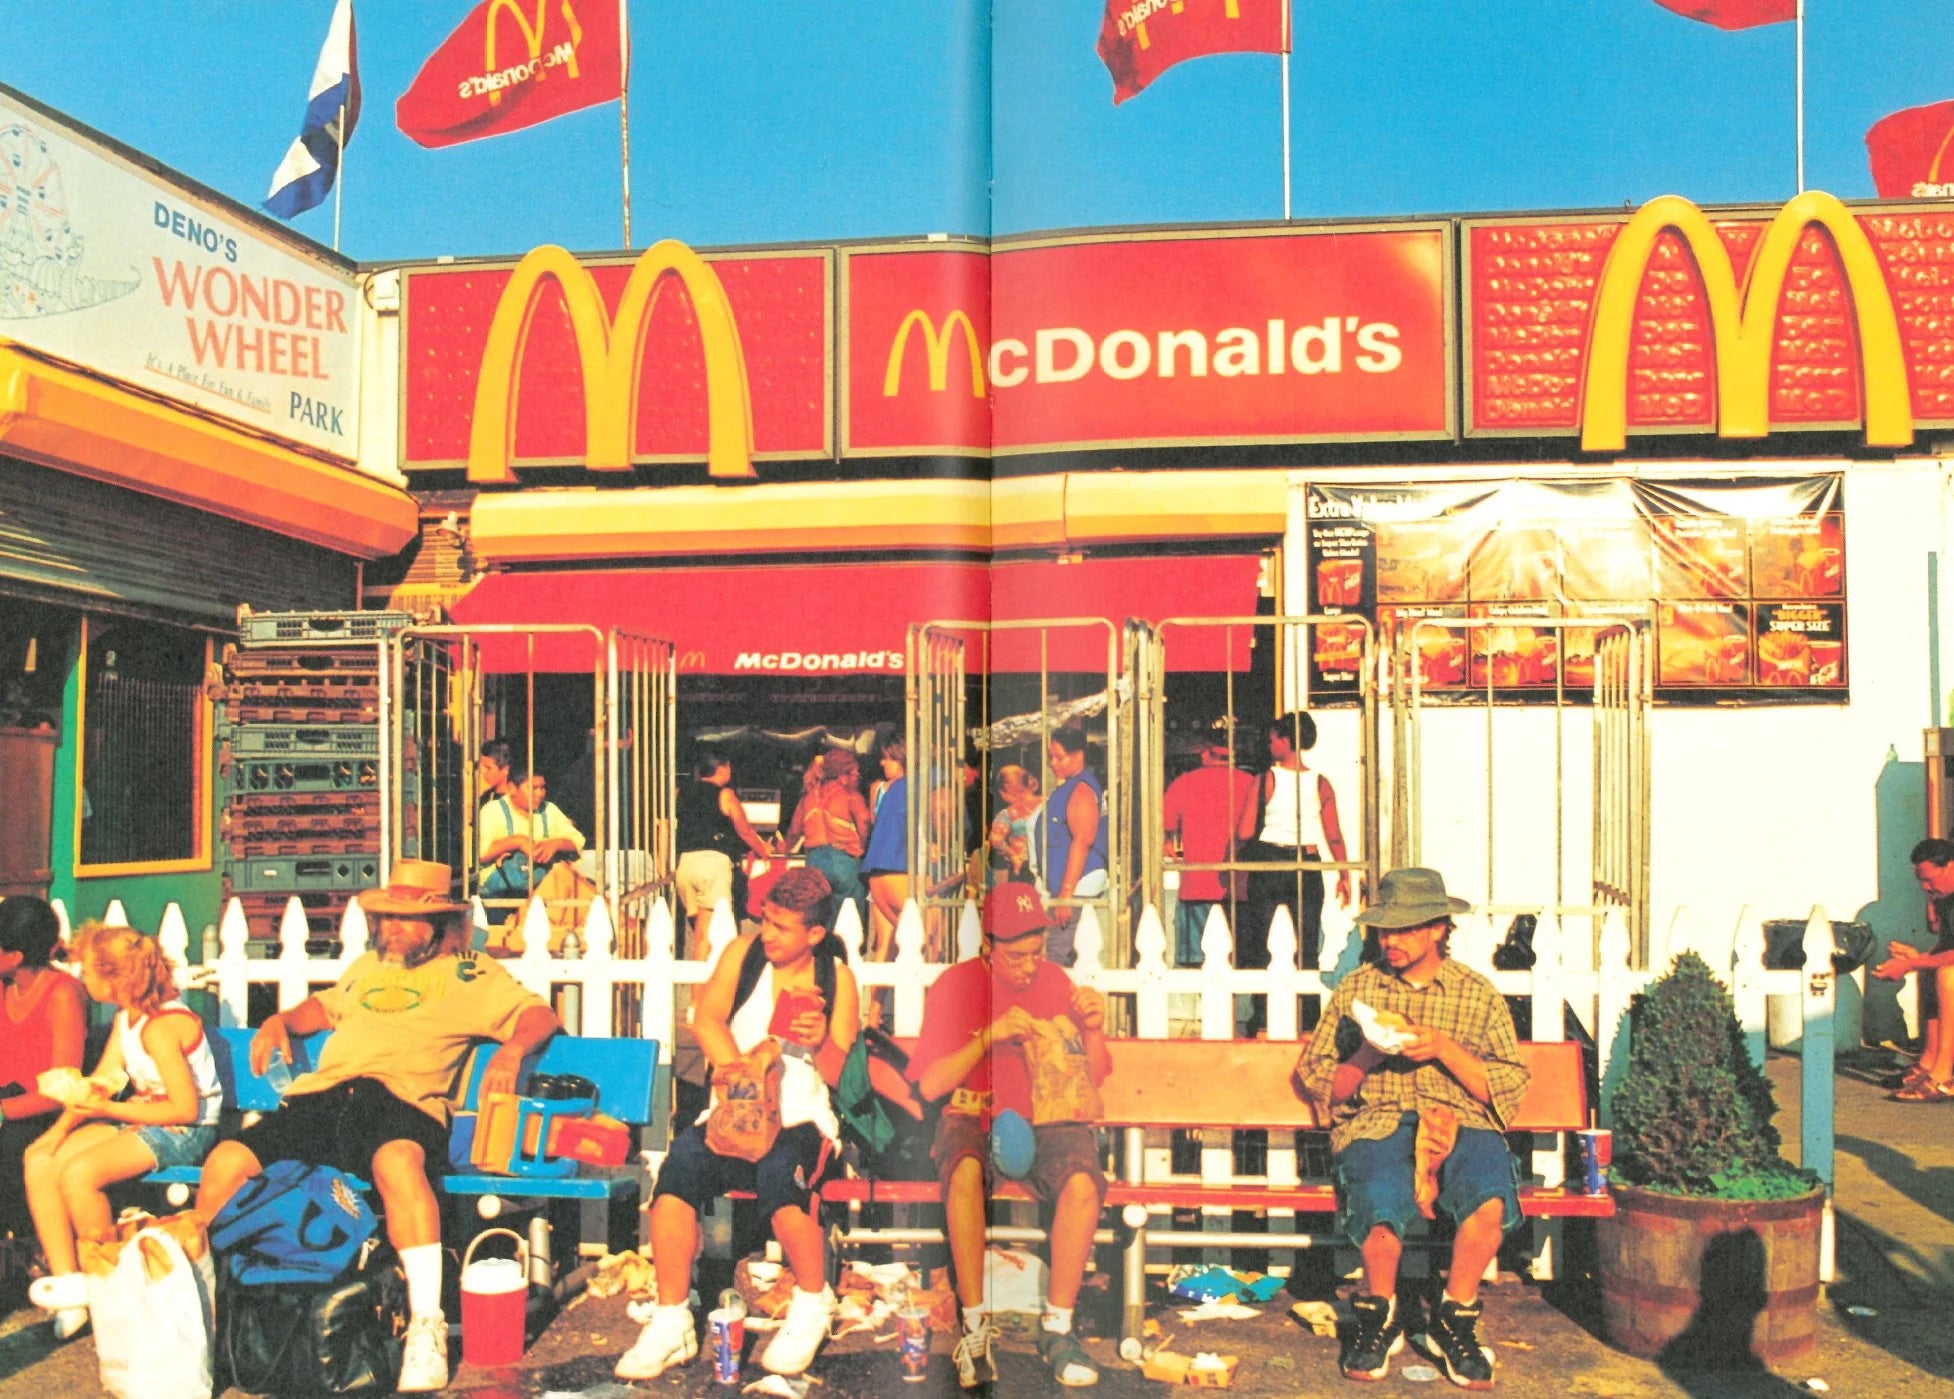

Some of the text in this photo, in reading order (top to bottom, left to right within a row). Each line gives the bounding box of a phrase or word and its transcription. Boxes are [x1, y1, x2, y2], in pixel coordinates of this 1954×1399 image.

[153, 200, 238, 263] DENO'S
[152, 255, 348, 334] WONDER
[186, 317, 329, 380] WHEEL
[883, 309, 1402, 398] McDonald's
[289, 391, 344, 436] PARK
[733, 650, 905, 671] McDonald's
